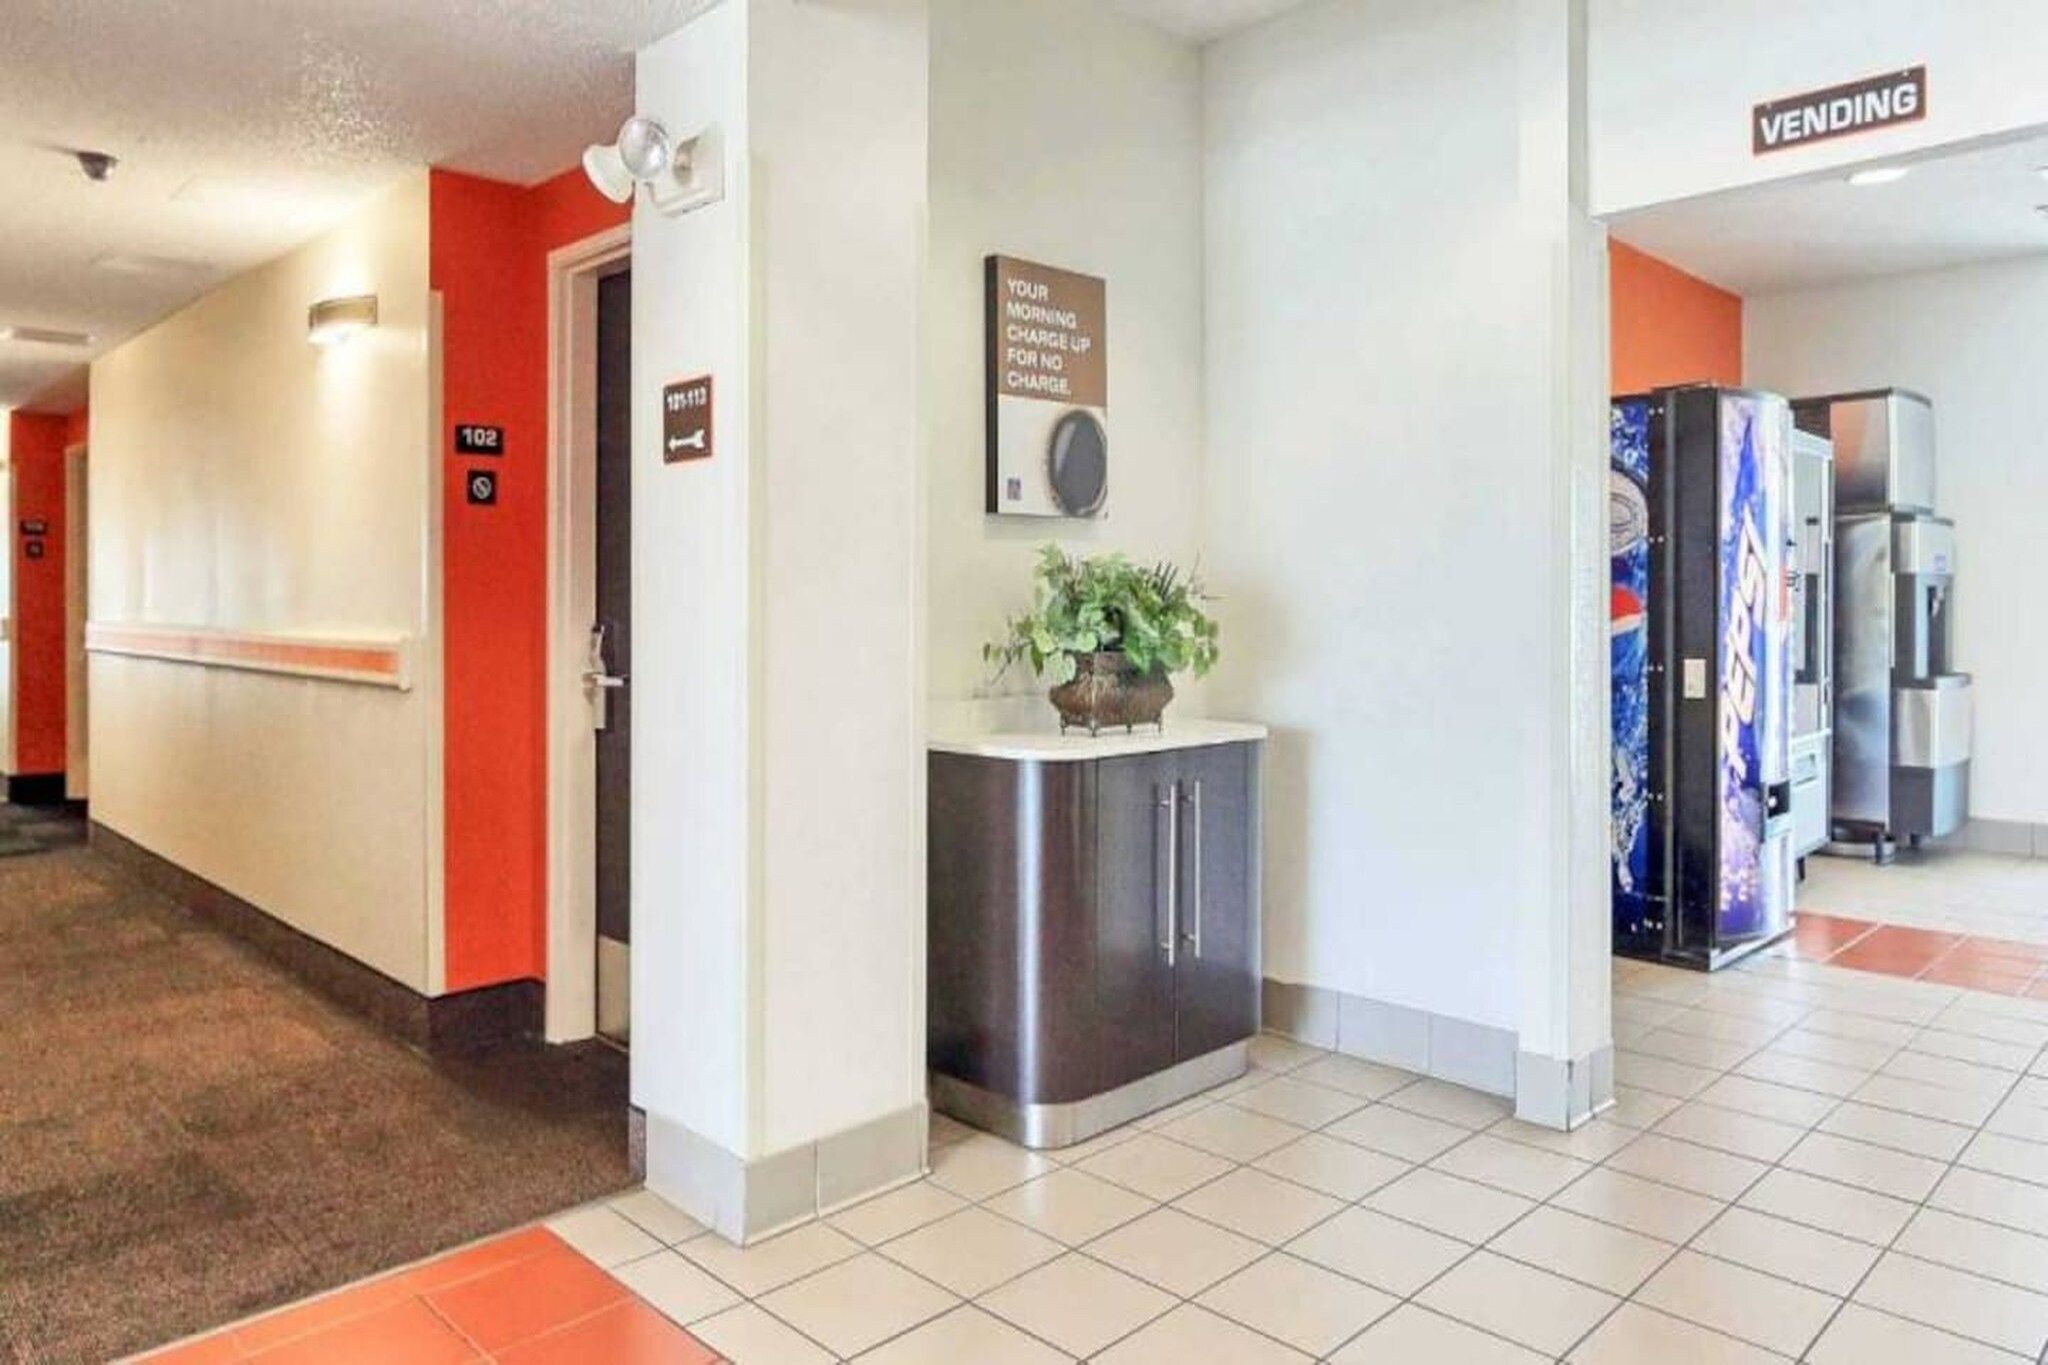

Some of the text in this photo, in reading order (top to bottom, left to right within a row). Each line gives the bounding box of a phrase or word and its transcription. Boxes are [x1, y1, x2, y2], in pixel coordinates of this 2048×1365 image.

[1760, 82, 1917, 145] VENDING
[1007, 278, 1048, 301] YOUR
[1006, 301, 1076, 329] MORNING
[1006, 323, 1091, 352] CHARGE UP
[1007, 347, 1063, 371] FOR NO
[1007, 370, 1072, 396] CHARGE.
[462, 427, 498, 447] 102
[1722, 502, 1767, 783] PEPSI
